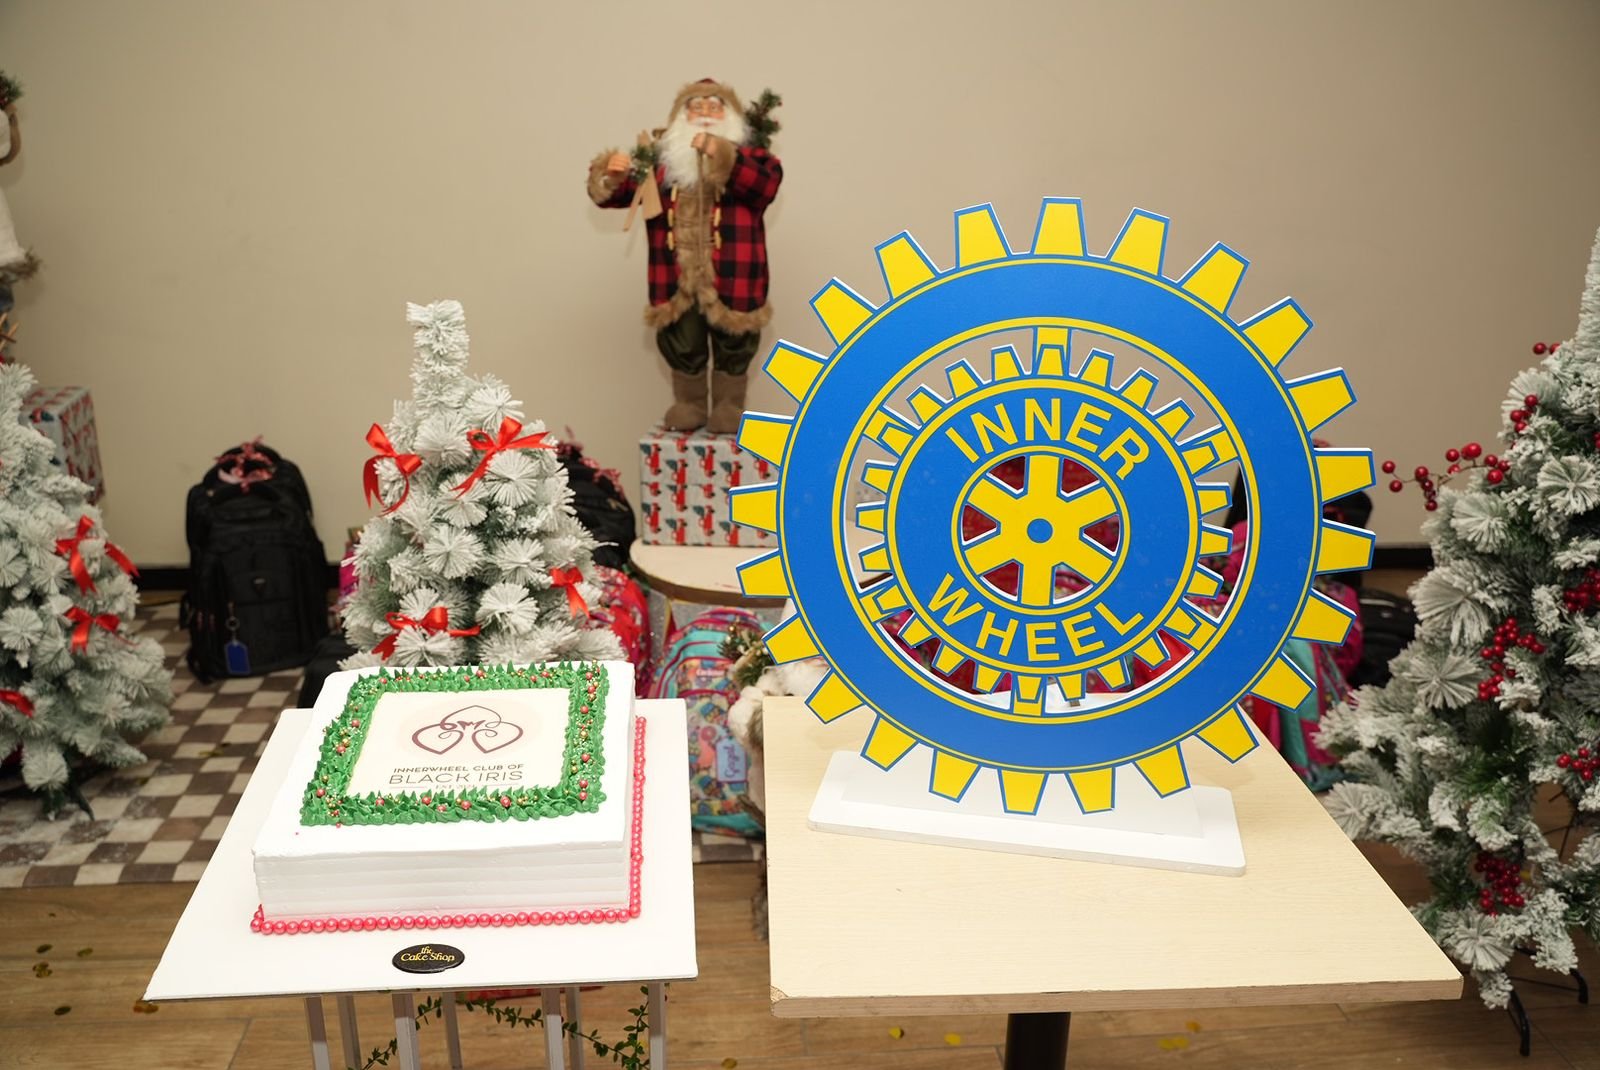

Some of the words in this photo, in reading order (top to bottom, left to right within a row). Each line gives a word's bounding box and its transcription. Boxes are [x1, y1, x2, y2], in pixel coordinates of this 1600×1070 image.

[945, 398, 1150, 480] INNER
[928, 573, 1144, 662] WHEEL
[393, 765, 469, 773] INNERWHEEL
[389, 773, 471, 785] BLACK
[478, 771, 523, 782] IRIS
[420, 946, 432, 954] the
[400, 953, 429, 961] Cake
[429, 952, 455, 962] Shop
